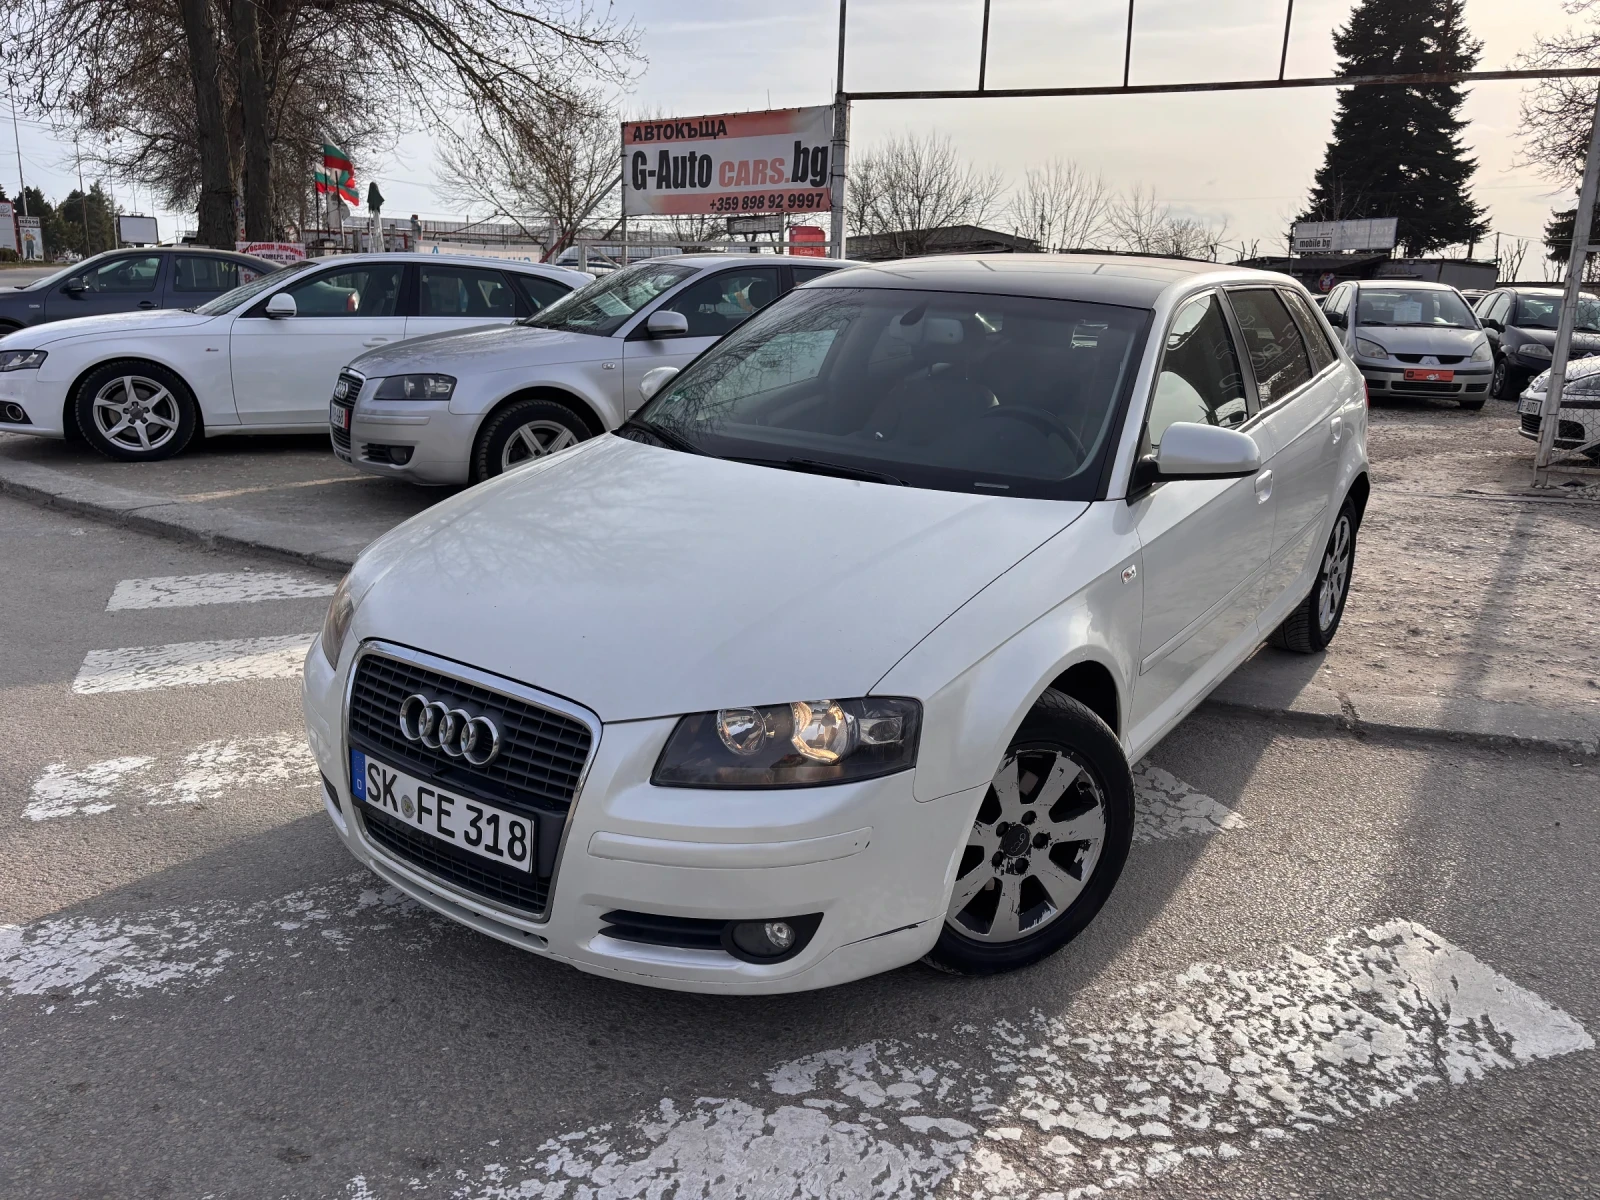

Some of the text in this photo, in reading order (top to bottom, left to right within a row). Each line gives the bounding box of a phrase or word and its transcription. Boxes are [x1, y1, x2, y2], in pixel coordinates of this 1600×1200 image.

[633, 119, 727, 141] АВТОКЪЩА
[632, 149, 712, 190] G-Auto
[710, 192, 824, 211] +359 898 92 9997
[356, 778, 362, 790] D
[367, 762, 527, 862] SK FE 318
